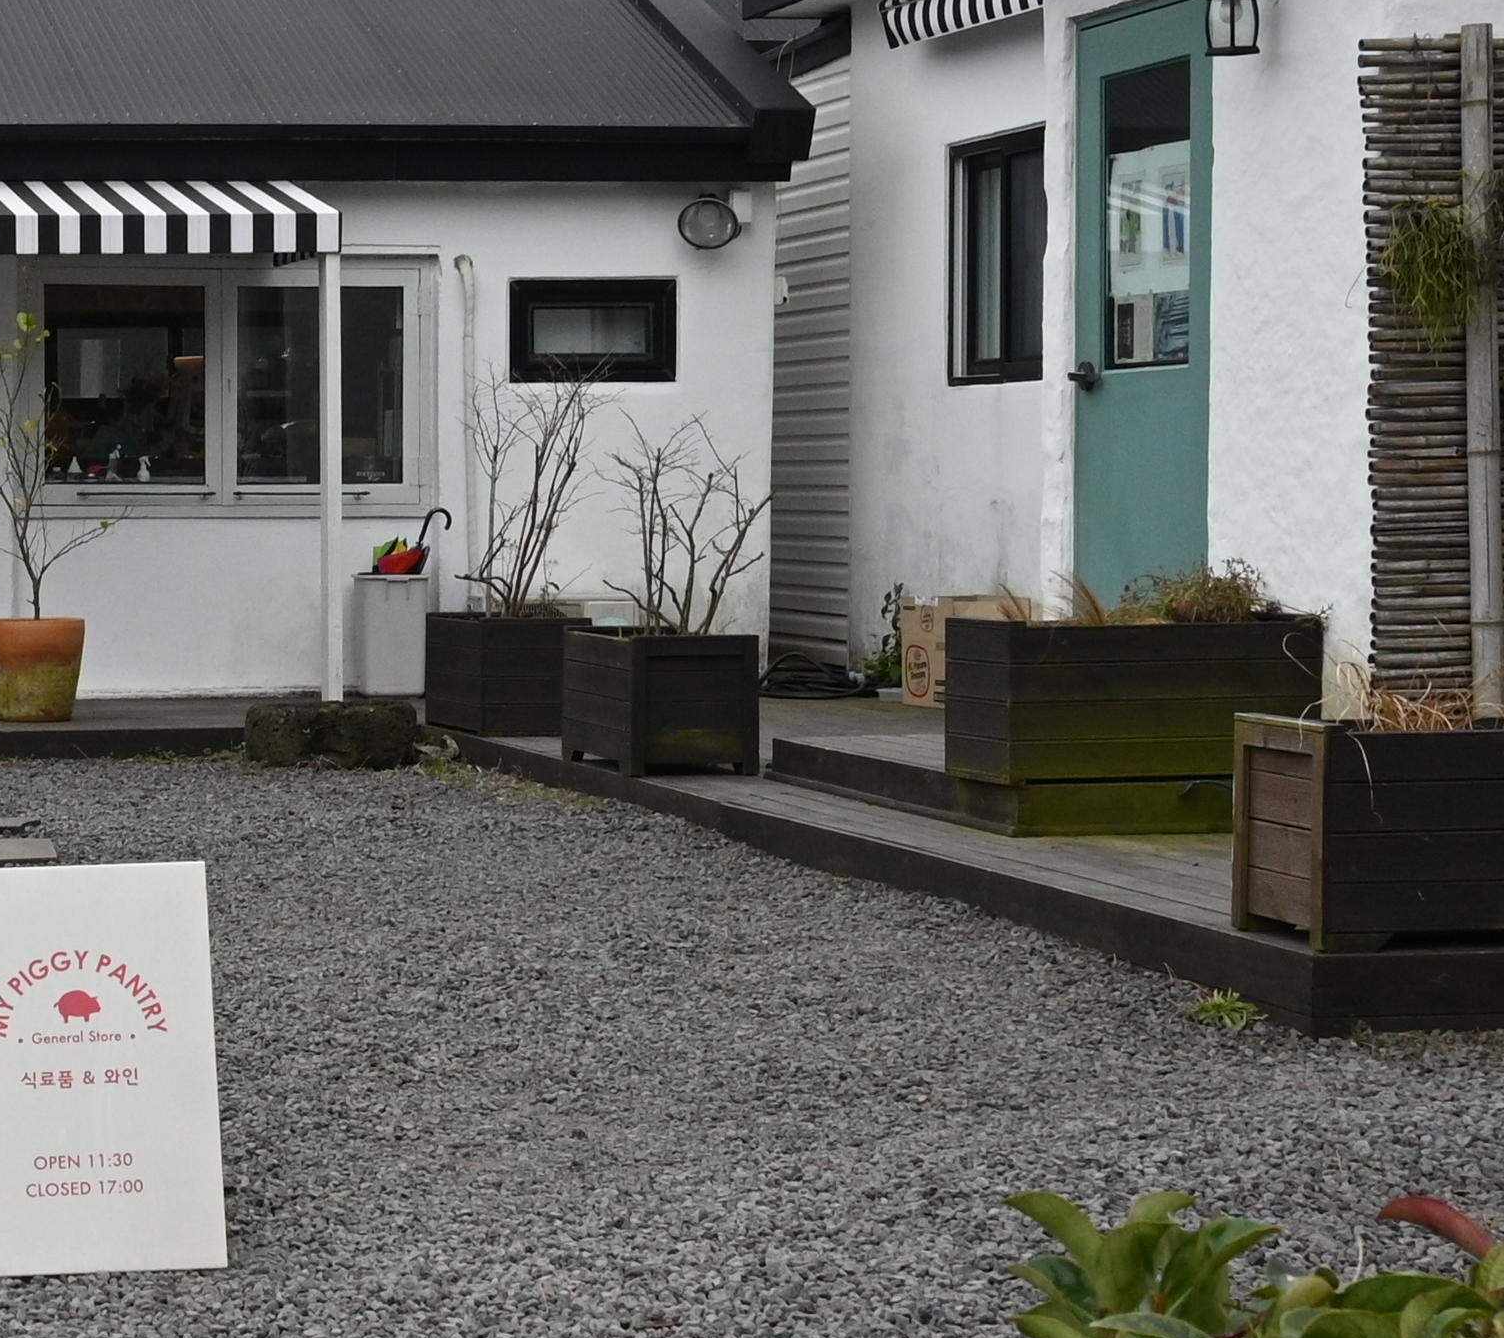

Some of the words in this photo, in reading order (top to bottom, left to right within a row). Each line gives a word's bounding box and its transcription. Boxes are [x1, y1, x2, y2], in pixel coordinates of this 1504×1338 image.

[7, 950, 89, 997] PIGGY
[95, 954, 169, 1034] PANTRY
[31, 1032, 84, 1045] General
[88, 1030, 122, 1043] Store
[20, 1070, 74, 1089] 식료품
[82, 1071, 96, 1085] &
[104, 1068, 139, 1086] 와인
[33, 1154, 81, 1171] OPEN
[88, 1152, 133, 1169] 11:30
[25, 1181, 91, 1198] CLOSED
[98, 1178, 144, 1195] 17:00
